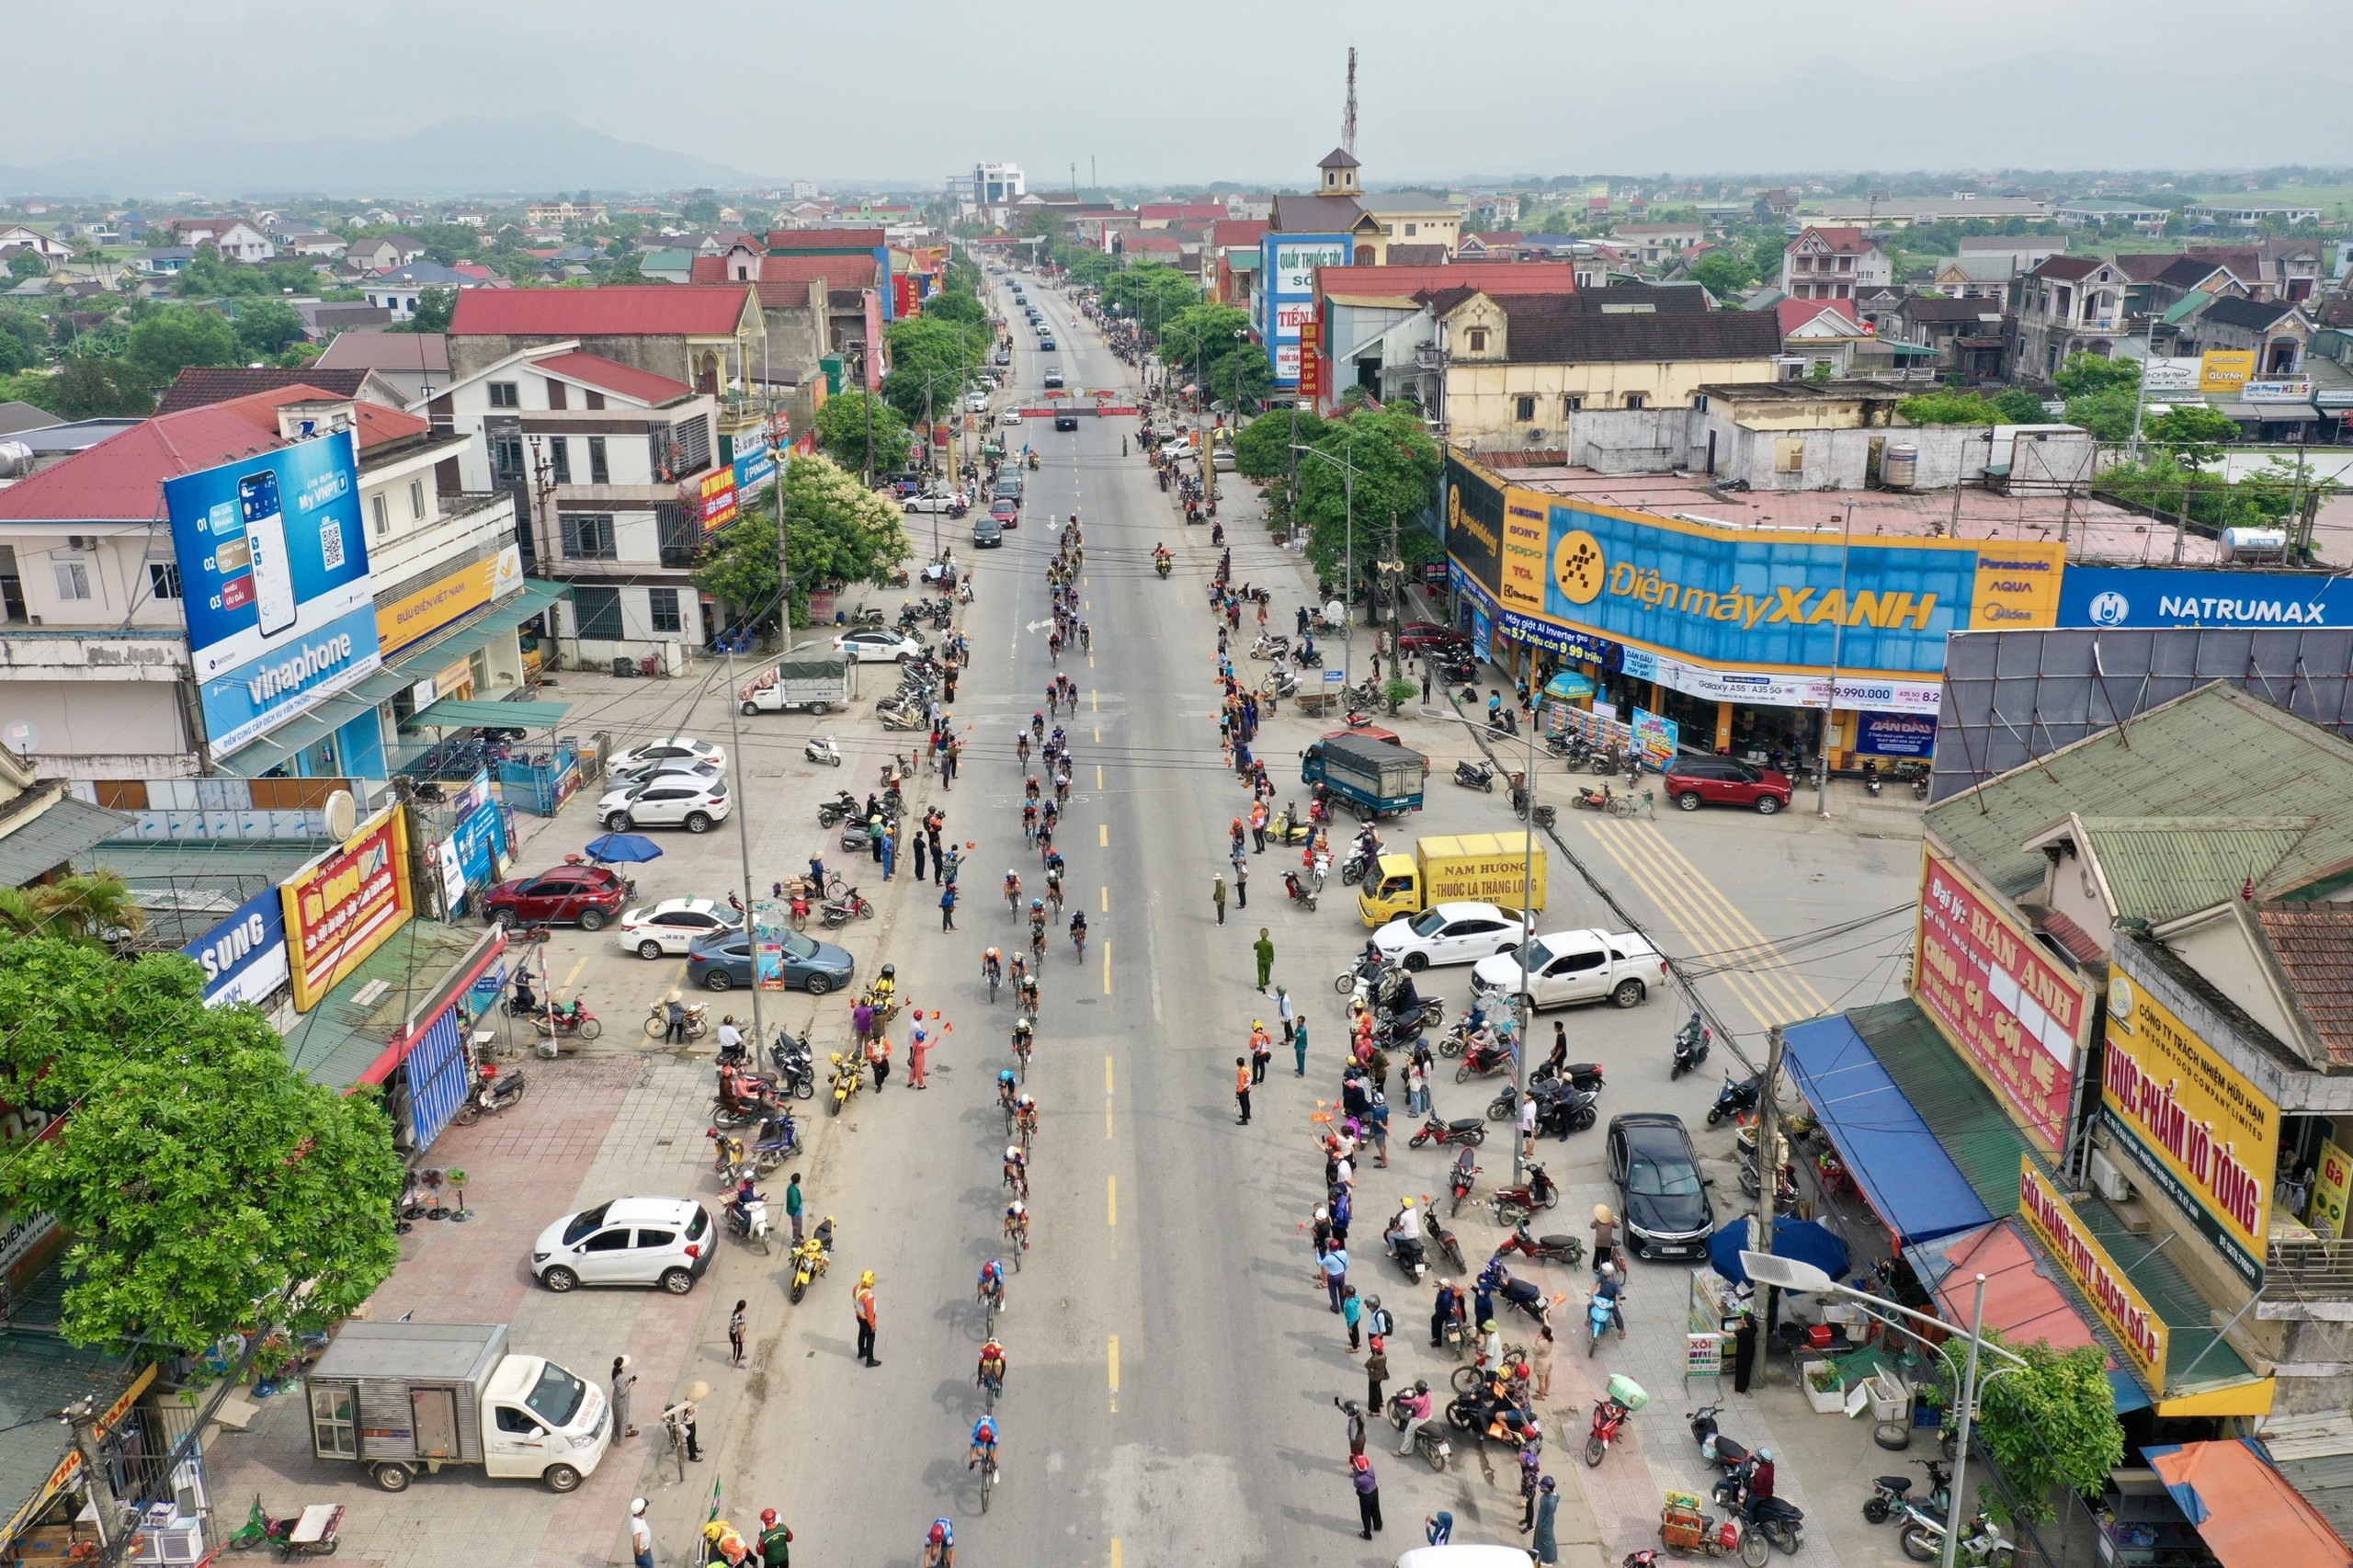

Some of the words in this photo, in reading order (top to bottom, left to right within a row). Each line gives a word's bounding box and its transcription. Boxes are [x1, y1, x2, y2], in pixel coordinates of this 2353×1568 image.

[299, 494, 313, 514] My
[314, 483, 338, 502] VNPT
[197, 517, 208, 532] 01
[214, 517, 234, 529] NHANH
[1509, 505, 1544, 521] SAMSUNG
[1509, 525, 1540, 540] SONY
[204, 557, 216, 571] 02
[1512, 565, 1533, 580] TCL
[1979, 557, 2051, 572] Panasonic
[1513, 590, 1539, 603] Electrolux
[1609, 561, 1679, 611] Điện
[1681, 585, 1775, 631] máy
[1764, 585, 1938, 631] XANH
[1989, 581, 2033, 593] AQUA
[210, 595, 222, 610] 03
[415, 597, 433, 616] ĐIỆN
[433, 588, 449, 607] VIỆT
[449, 583, 466, 597] NAM
[2159, 595, 2325, 625] NATRUMAX
[1993, 608, 2032, 620] Midea
[1506, 613, 1520, 628] Máy
[1521, 619, 1536, 632] giặt
[1546, 624, 1575, 642] Inverter
[1527, 632, 1544, 647] triệu
[1544, 640, 1558, 651] còn
[1560, 642, 1583, 658] 9,99
[1585, 651, 1603, 665] triệu
[246, 633, 352, 705] vinaphone
[1699, 680, 1729, 693] Galaxy
[1751, 686, 1768, 694] A35
[1833, 687, 1891, 699] 9.990.000
[237, 726, 253, 741] CUNG
[252, 719, 264, 733] CẤP
[263, 712, 276, 727] DỊCH
[283, 700, 295, 716] VIỄN
[1444, 865, 1475, 876] NAM
[1480, 862, 1527, 874] HƯƠNG
[1467, 879, 1479, 896] LÁ
[1482, 878, 1511, 895] THĂNG
[1514, 878, 1537, 893] LOG
[194, 914, 265, 982] SUNG
[1932, 878, 1951, 910] Đại
[1971, 906, 2018, 972] HÁN
[2021, 959, 2074, 1028] ANH
[2139, 1003, 2161, 1031] CÔNG
[2163, 1024, 2173, 1041] TY
[2174, 1032, 2200, 1066] TRÁCH
[2200, 1057, 2226, 1090] NHIỆM
[2227, 1081, 2245, 1107] HỮU
[2245, 1097, 2265, 1126] HẠN
[2172, 1053, 2192, 1077] FOOD
[2193, 1074, 2231, 1112] COMPANY
[2231, 1107, 2263, 1142] LIMITED
[2105, 1037, 2142, 1115] THỰC
[2141, 1077, 2188, 1164] PHẨM
[2212, 1141, 2262, 1238] TÒNG
[2325, 1158, 2344, 1189] Gà
[2188, 1202, 2200, 1221] ANH
[2021, 1169, 2042, 1220] CỬA
[2042, 1199, 2073, 1256] HÀNG
[2147, 1331, 2159, 1364] 8
[2031, 1216, 2056, 1251] NGUYÊN
[2056, 1248, 2074, 1273] CHẤT
[2087, 1290, 2107, 1316] TOÀN
[2127, 1339, 2149, 1373] NGON
